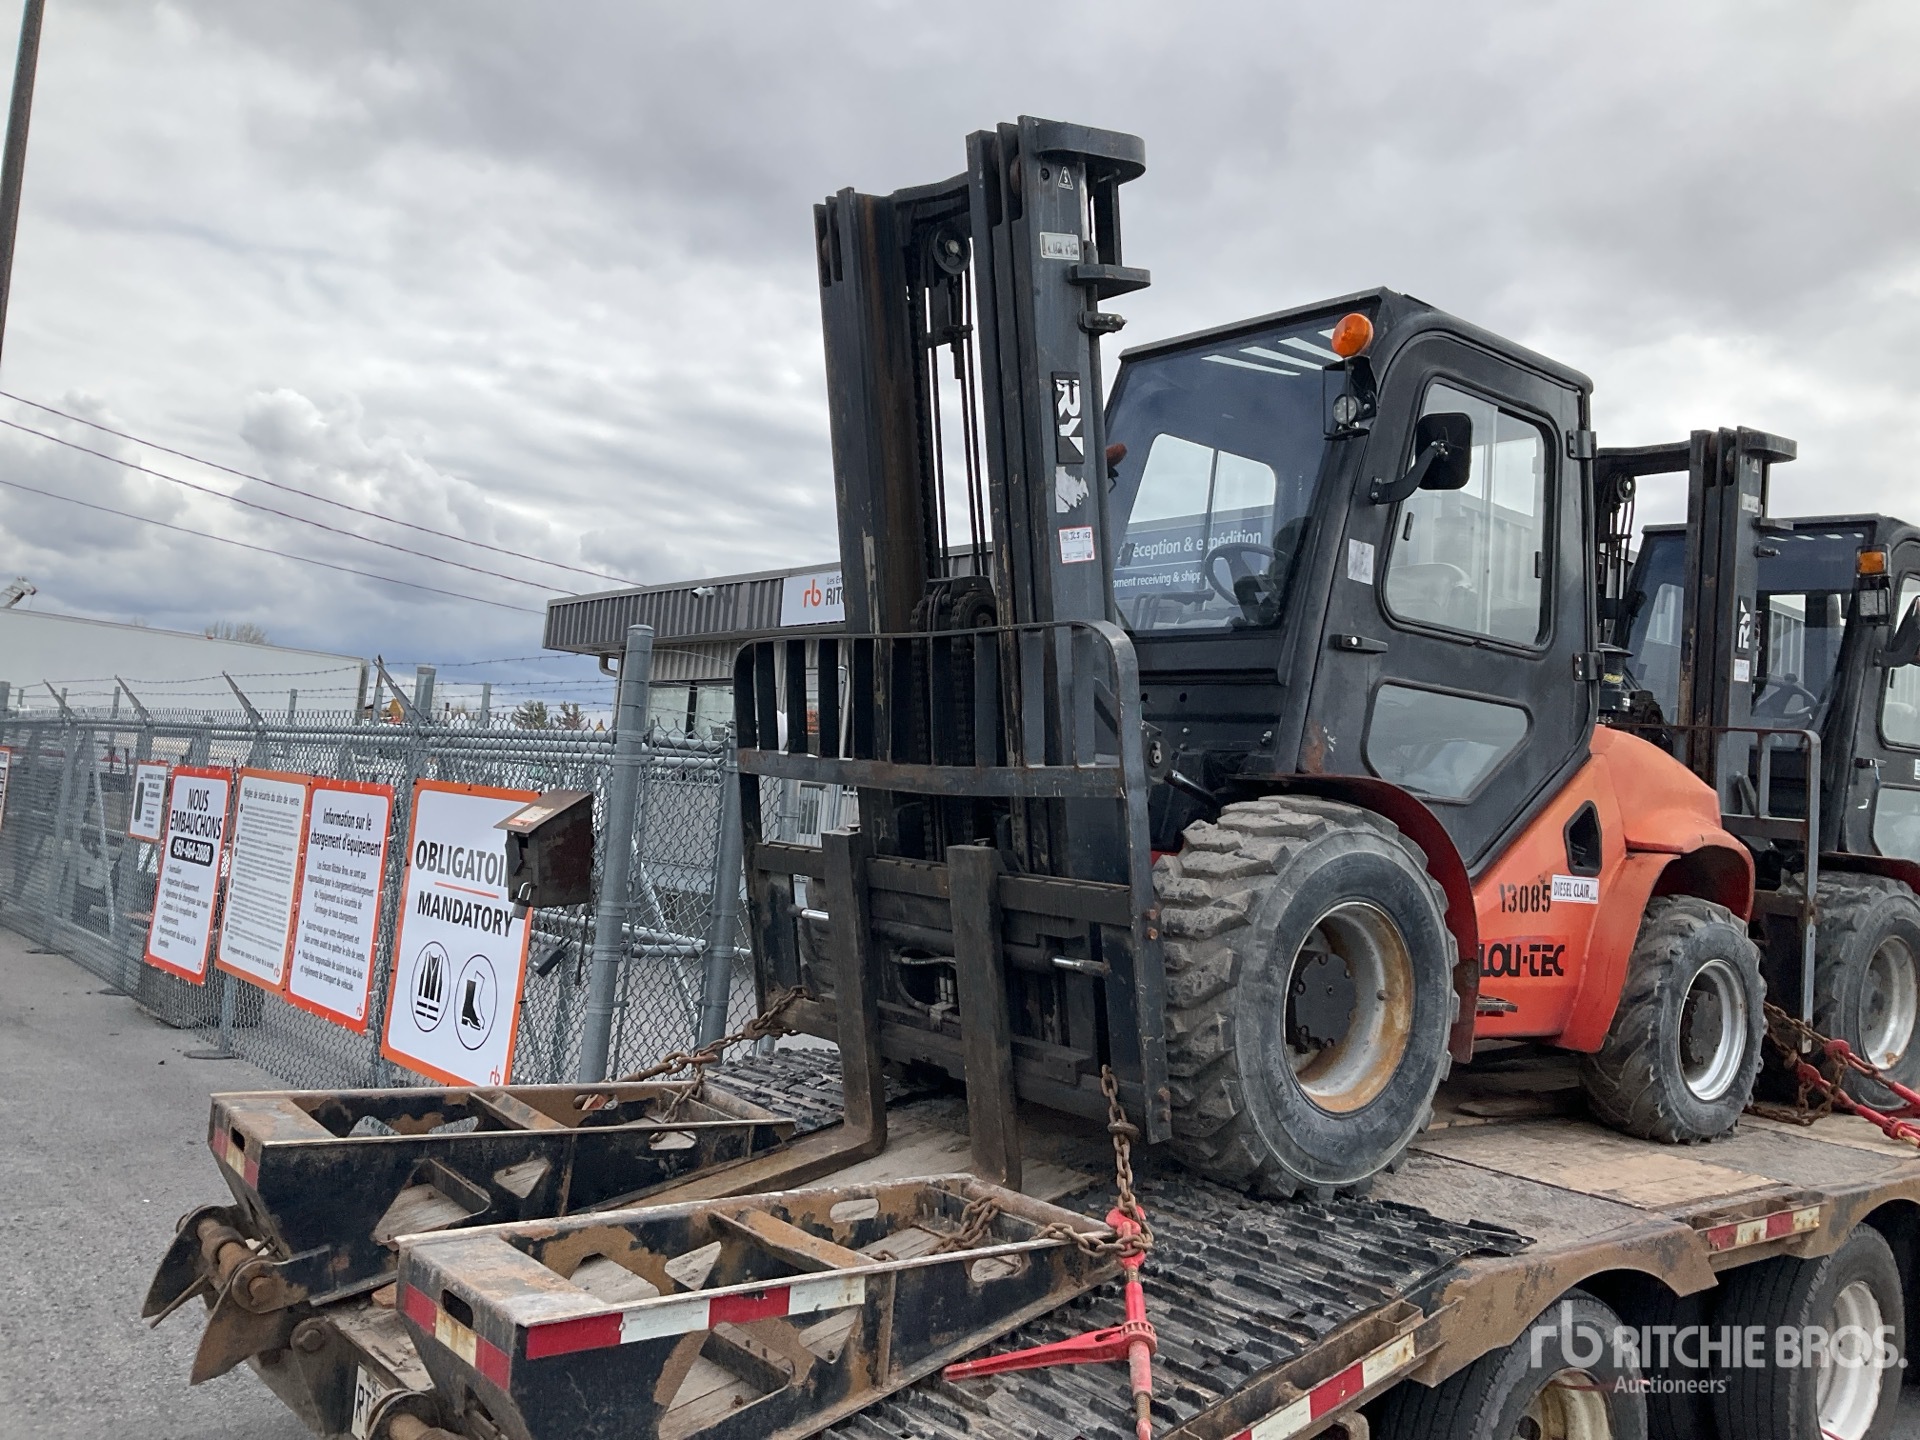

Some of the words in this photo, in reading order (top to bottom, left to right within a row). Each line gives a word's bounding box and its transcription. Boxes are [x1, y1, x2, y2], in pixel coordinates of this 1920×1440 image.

[1130, 538, 1180, 560] éception
[1137, 572, 1171, 586] receiving
[803, 578, 822, 608] rb
[187, 789, 210, 811] NOUS
[170, 810, 222, 839] EMBAUCHONS
[324, 807, 356, 826] Information
[356, 816, 365, 829] sur
[366, 814, 372, 830] le
[311, 828, 342, 852] chargement
[342, 833, 381, 860] d'équipement
[415, 840, 508, 888] OBLIGATOI
[1500, 884, 1551, 913] 13085
[1553, 881, 1572, 897] DIESEL
[1573, 883, 1590, 898] CLAIR
[417, 891, 513, 938] MANDATORY
[489, 1065, 501, 1086] rb
